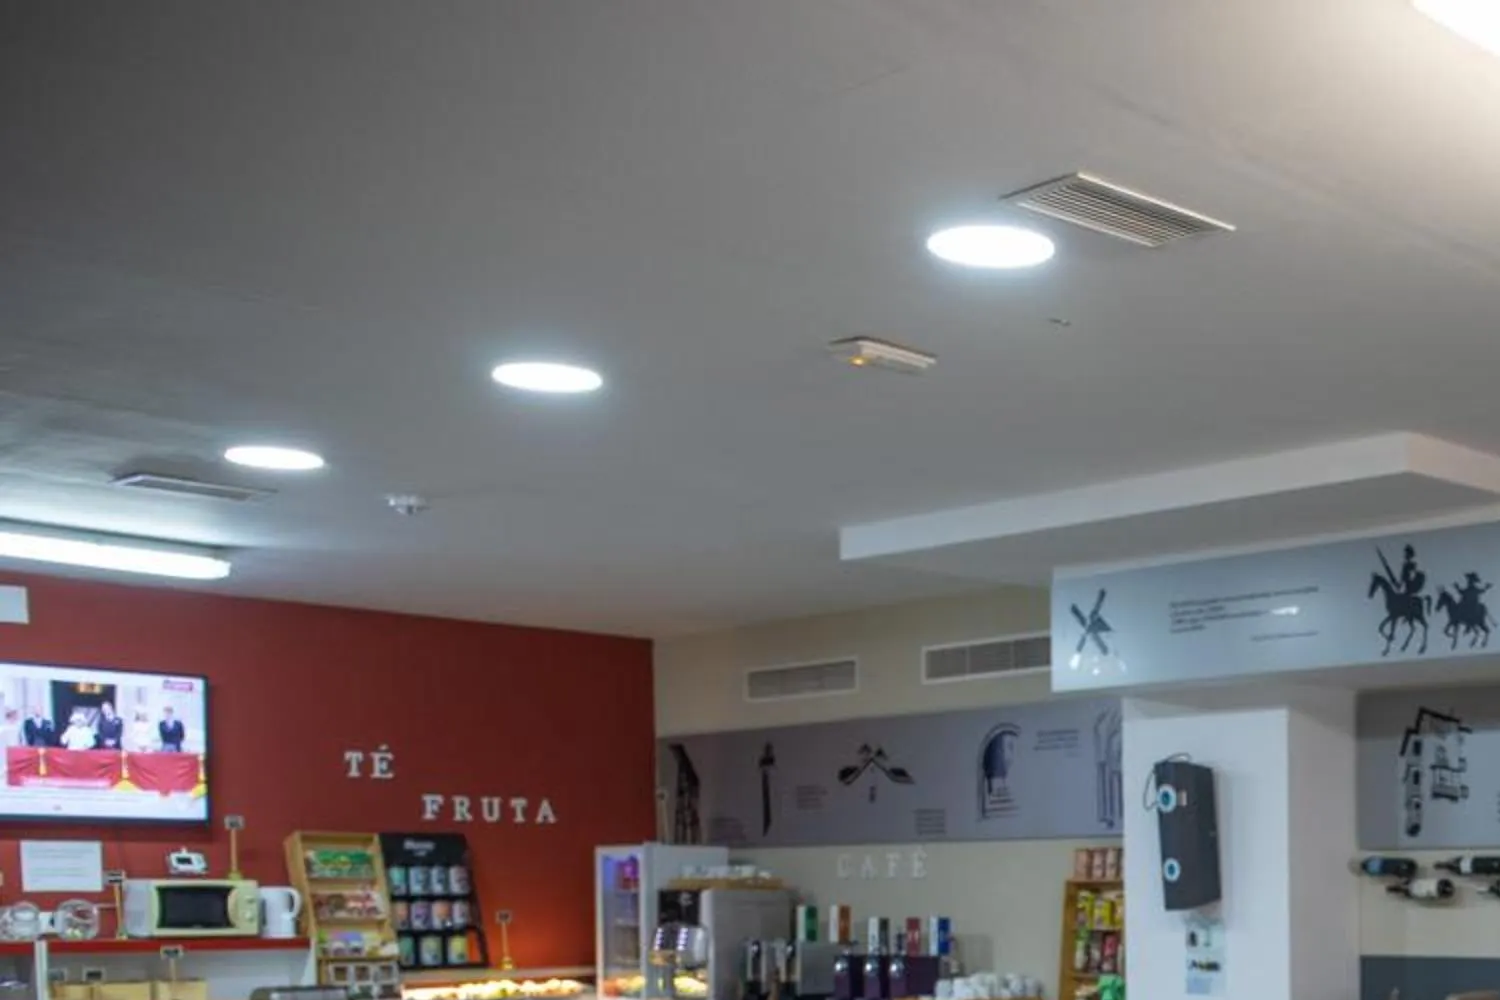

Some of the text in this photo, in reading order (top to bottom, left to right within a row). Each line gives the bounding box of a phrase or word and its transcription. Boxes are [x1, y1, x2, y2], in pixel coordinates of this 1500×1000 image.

[344, 743, 395, 779] TÉ
[421, 793, 558, 824] FRUTA
[837, 846, 928, 878] CAFÉ
